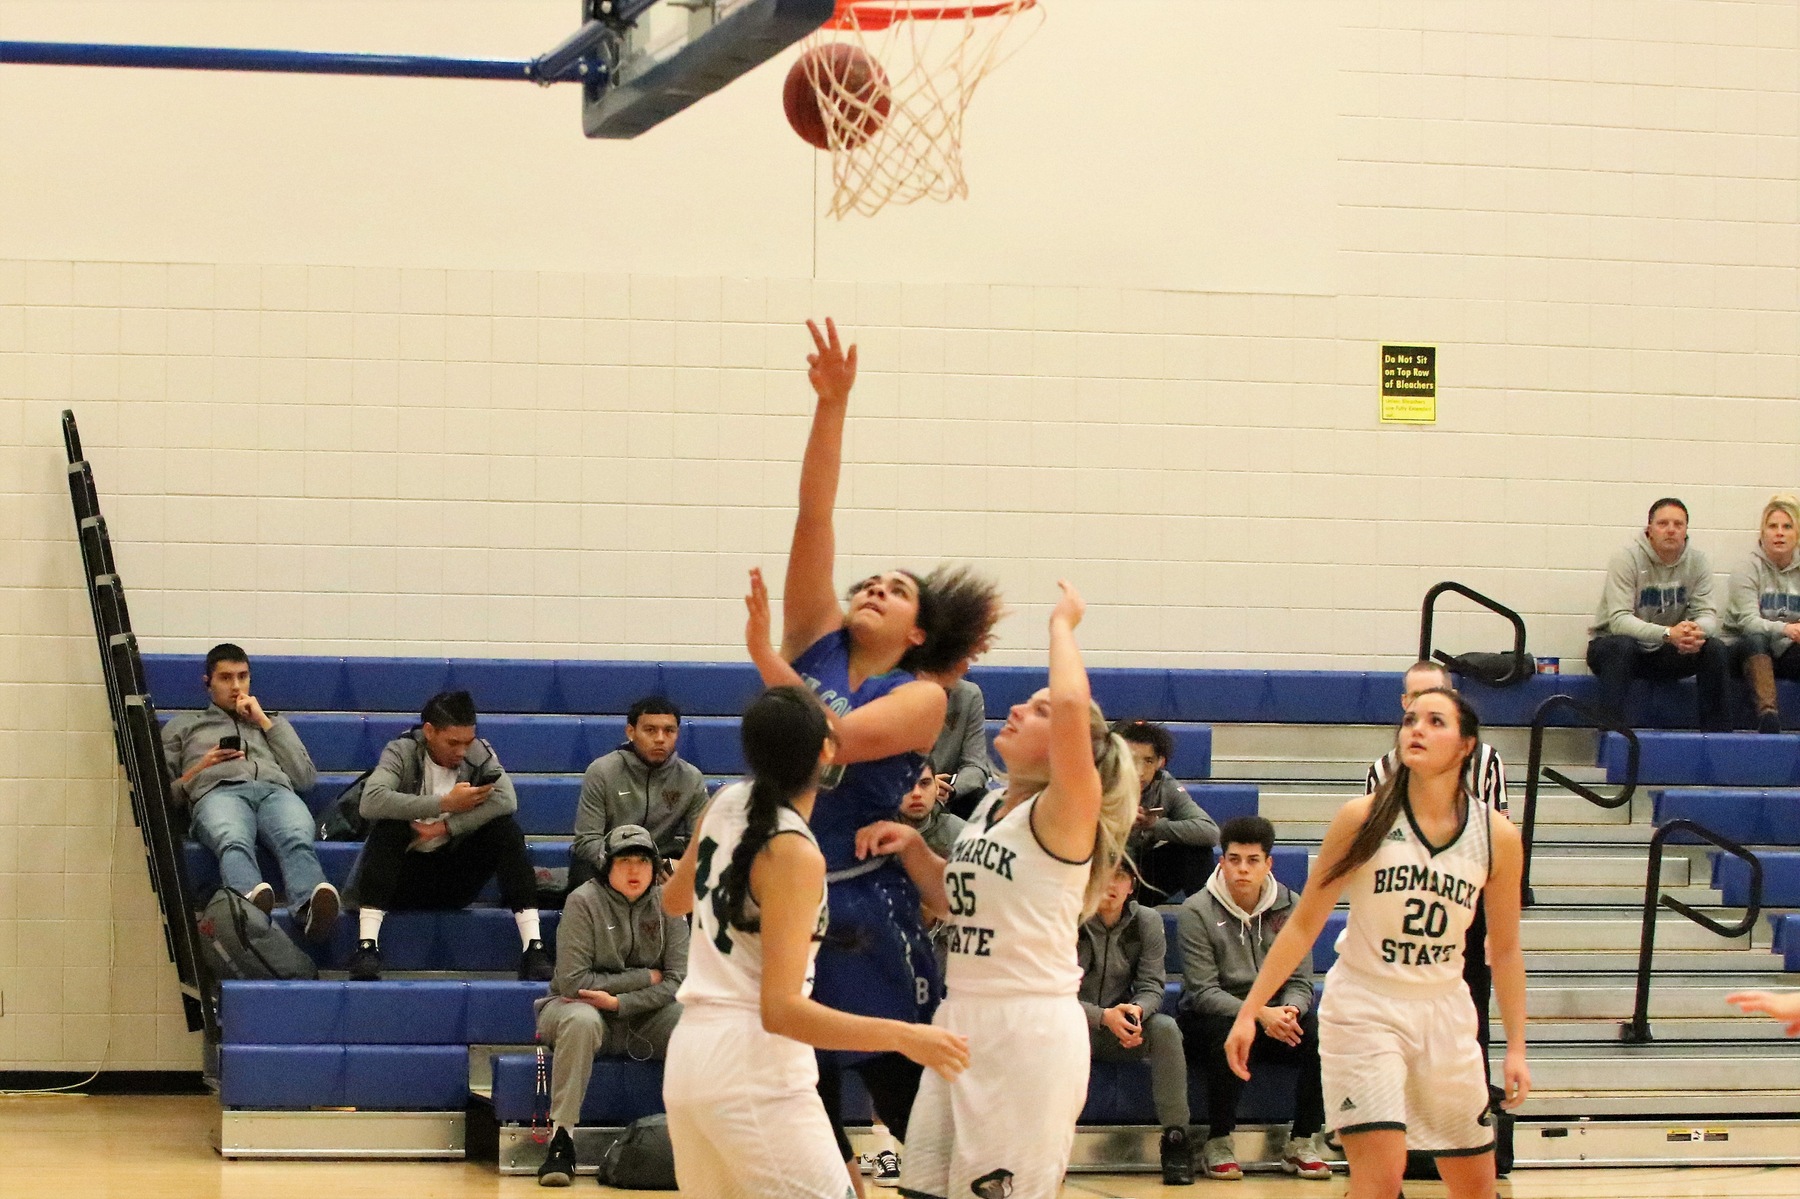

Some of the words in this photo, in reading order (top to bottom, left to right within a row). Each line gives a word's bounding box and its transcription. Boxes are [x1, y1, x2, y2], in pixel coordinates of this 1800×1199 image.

[1385, 355, 1395, 363] Do
[1398, 355, 1412, 363] Not
[1417, 356, 1427, 364] Sit
[1385, 380, 1393, 388] of
[1396, 380, 1434, 389] Bleachers
[1397, 368, 1411, 378] Top
[1413, 368, 1430, 377] Row
[946, 871, 977, 917] 35
[1373, 864, 1477, 910] BISMARCK
[1401, 898, 1449, 938] 20
